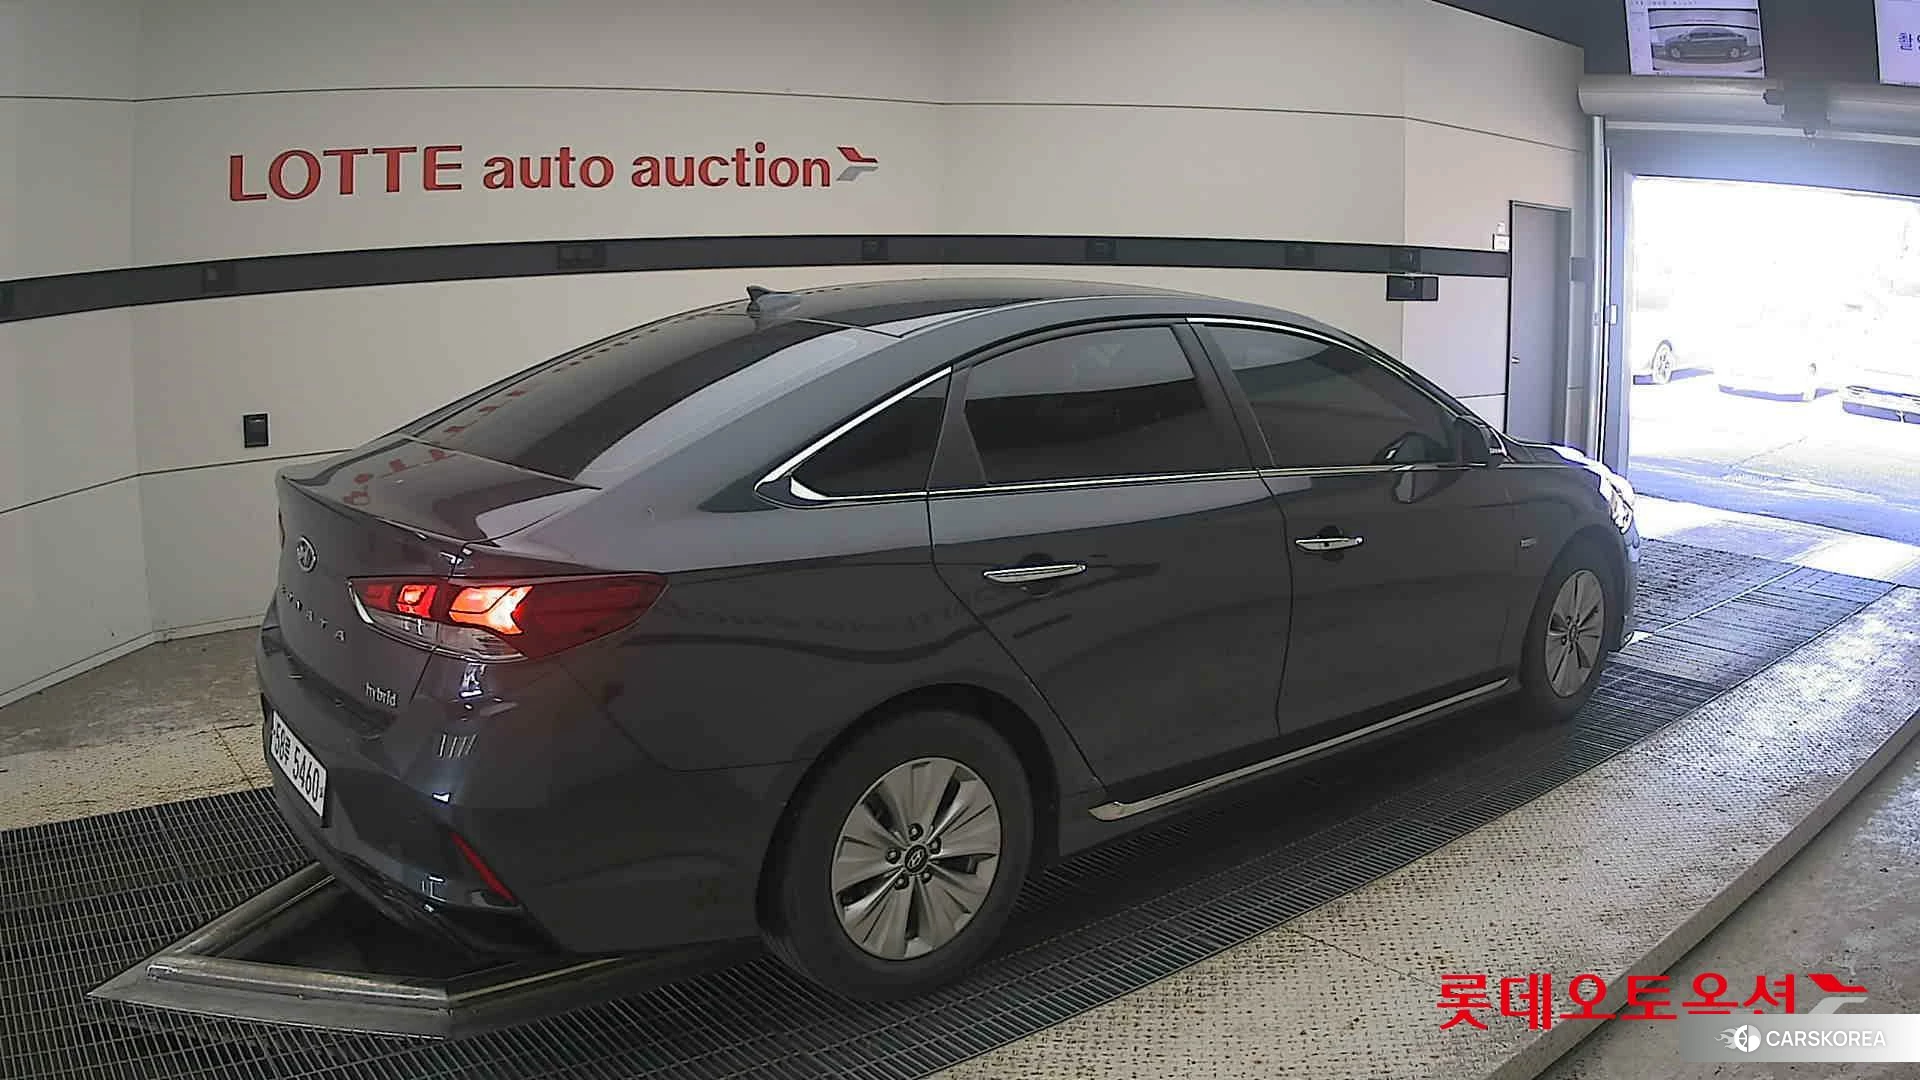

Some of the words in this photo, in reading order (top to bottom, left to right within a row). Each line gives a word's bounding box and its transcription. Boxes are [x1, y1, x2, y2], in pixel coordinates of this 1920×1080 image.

[229, 145, 462, 201] LOTTE
[483, 147, 614, 189] auto
[631, 142, 831, 188] auction
[365, 681, 398, 707] hybrid
[292, 745, 320, 803] 5460
